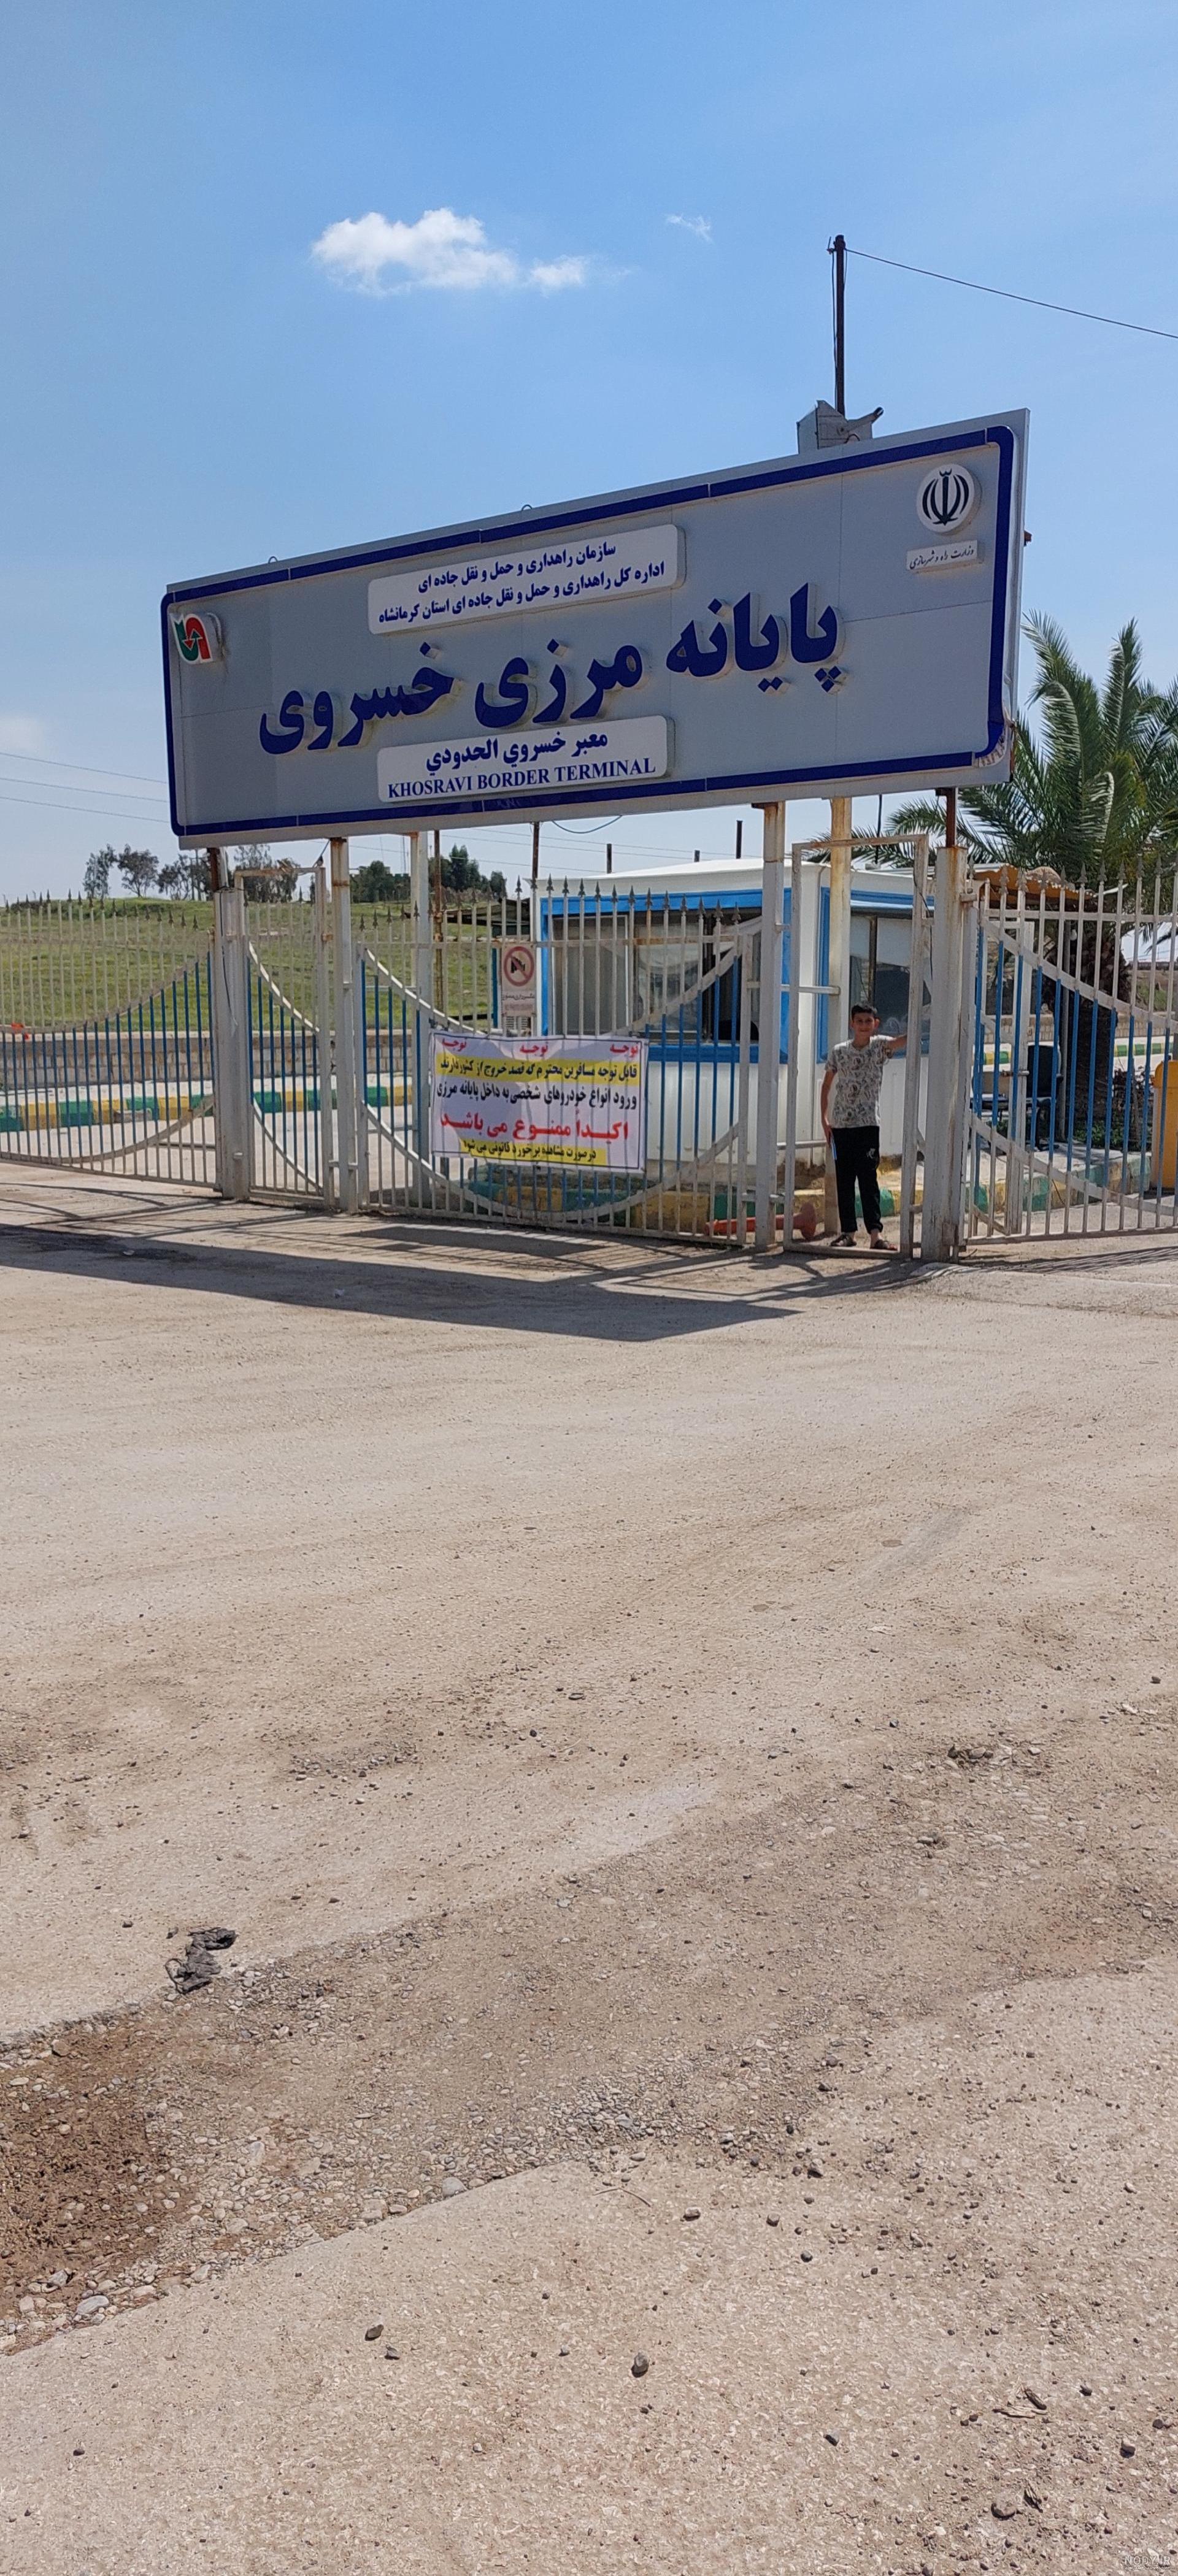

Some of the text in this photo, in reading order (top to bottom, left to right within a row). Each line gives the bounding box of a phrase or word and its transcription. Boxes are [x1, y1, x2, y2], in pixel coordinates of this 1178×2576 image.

[418, 542, 615, 593] سازمان راهداری و حمل و نقل جاده ای
[379, 561, 664, 623] اداره کل راهداری و حمل و نقل جاده ای استان کرمانشاه
[260, 583, 841, 754] پایانه مرزی خسروی
[572, 733, 608, 757] معبر
[388, 757, 655, 798] KHOSRAVI BORDER TERMINAL
[442, 1038, 467, 1052] توجه
[520, 1041, 548, 1057] توجه
[610, 1043, 638, 1057] توجه
[460, 1060, 474, 1075] کشور
[477, 1060, 483, 1076] از
[484, 1062, 506, 1077] خروج
[509, 1062, 525, 1075] قصد
[526, 1063, 535, 1075] که
[537, 1064, 562, 1078] محترم
[564, 1063, 595, 1079] مسافرین
[598, 1067, 617, 1081] توجه
[618, 1064, 637, 1081] قابل
[437, 1080, 636, 1110] ورود انواع خودروهای شخصی به داخل پایانه مرزی
[441, 1112, 483, 1135] باشد
[487, 1122, 507, 1137] می
[513, 1119, 571, 1140] ممنوع
[477, 1144, 487, 1153] می
[488, 1141, 510, 1156] قانونی
[542, 1144, 564, 1157] مشاهده
